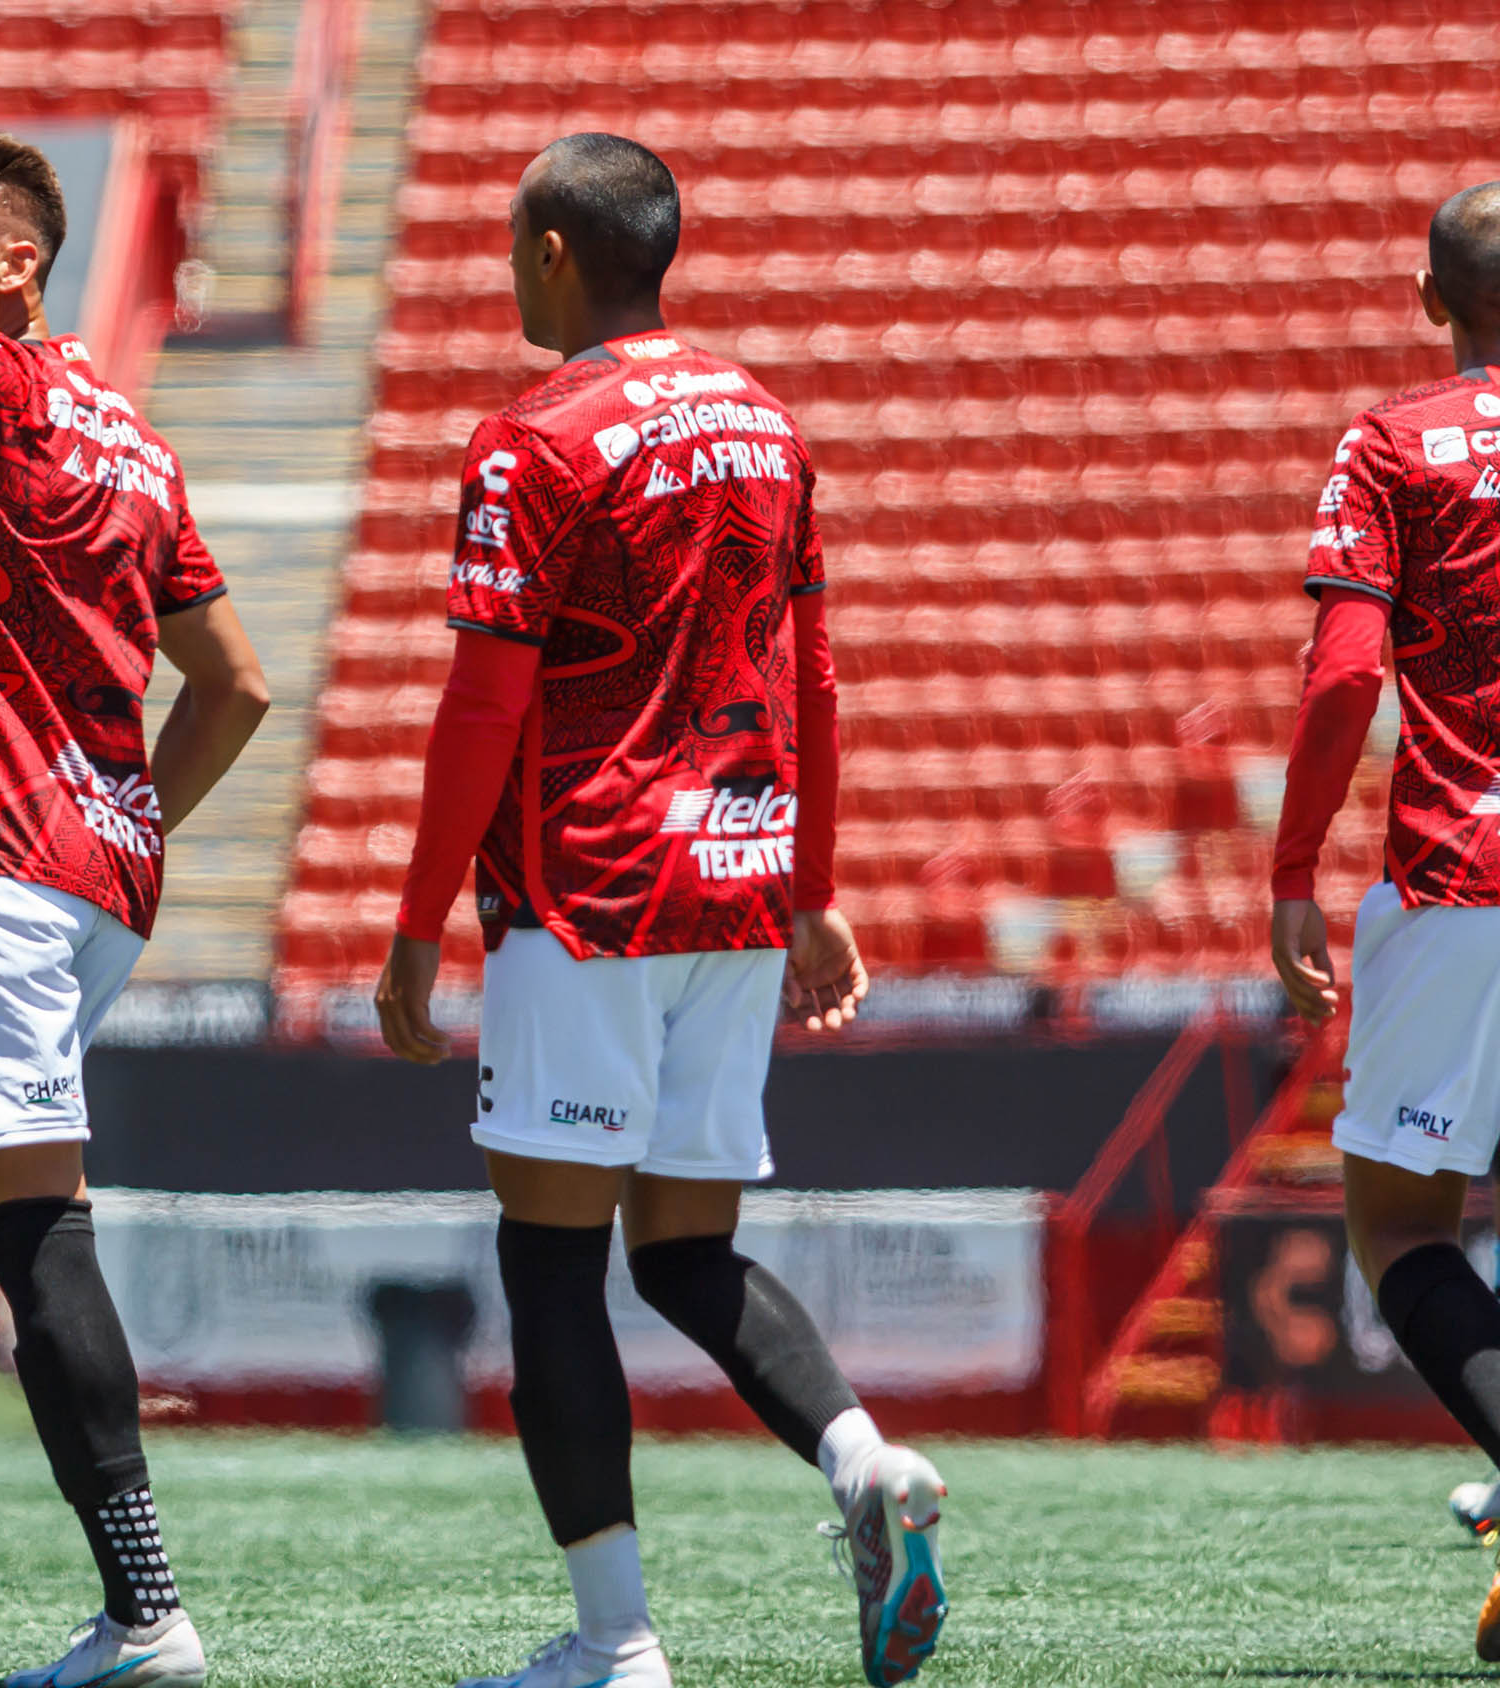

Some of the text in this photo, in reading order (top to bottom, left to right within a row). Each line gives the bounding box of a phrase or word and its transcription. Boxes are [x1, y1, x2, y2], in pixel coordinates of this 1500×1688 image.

[640, 400, 793, 448] caliente.mx
[691, 440, 791, 488] AFIRME
[689, 835, 795, 880] TECATE
[550, 1099, 628, 1126] CHARLY
